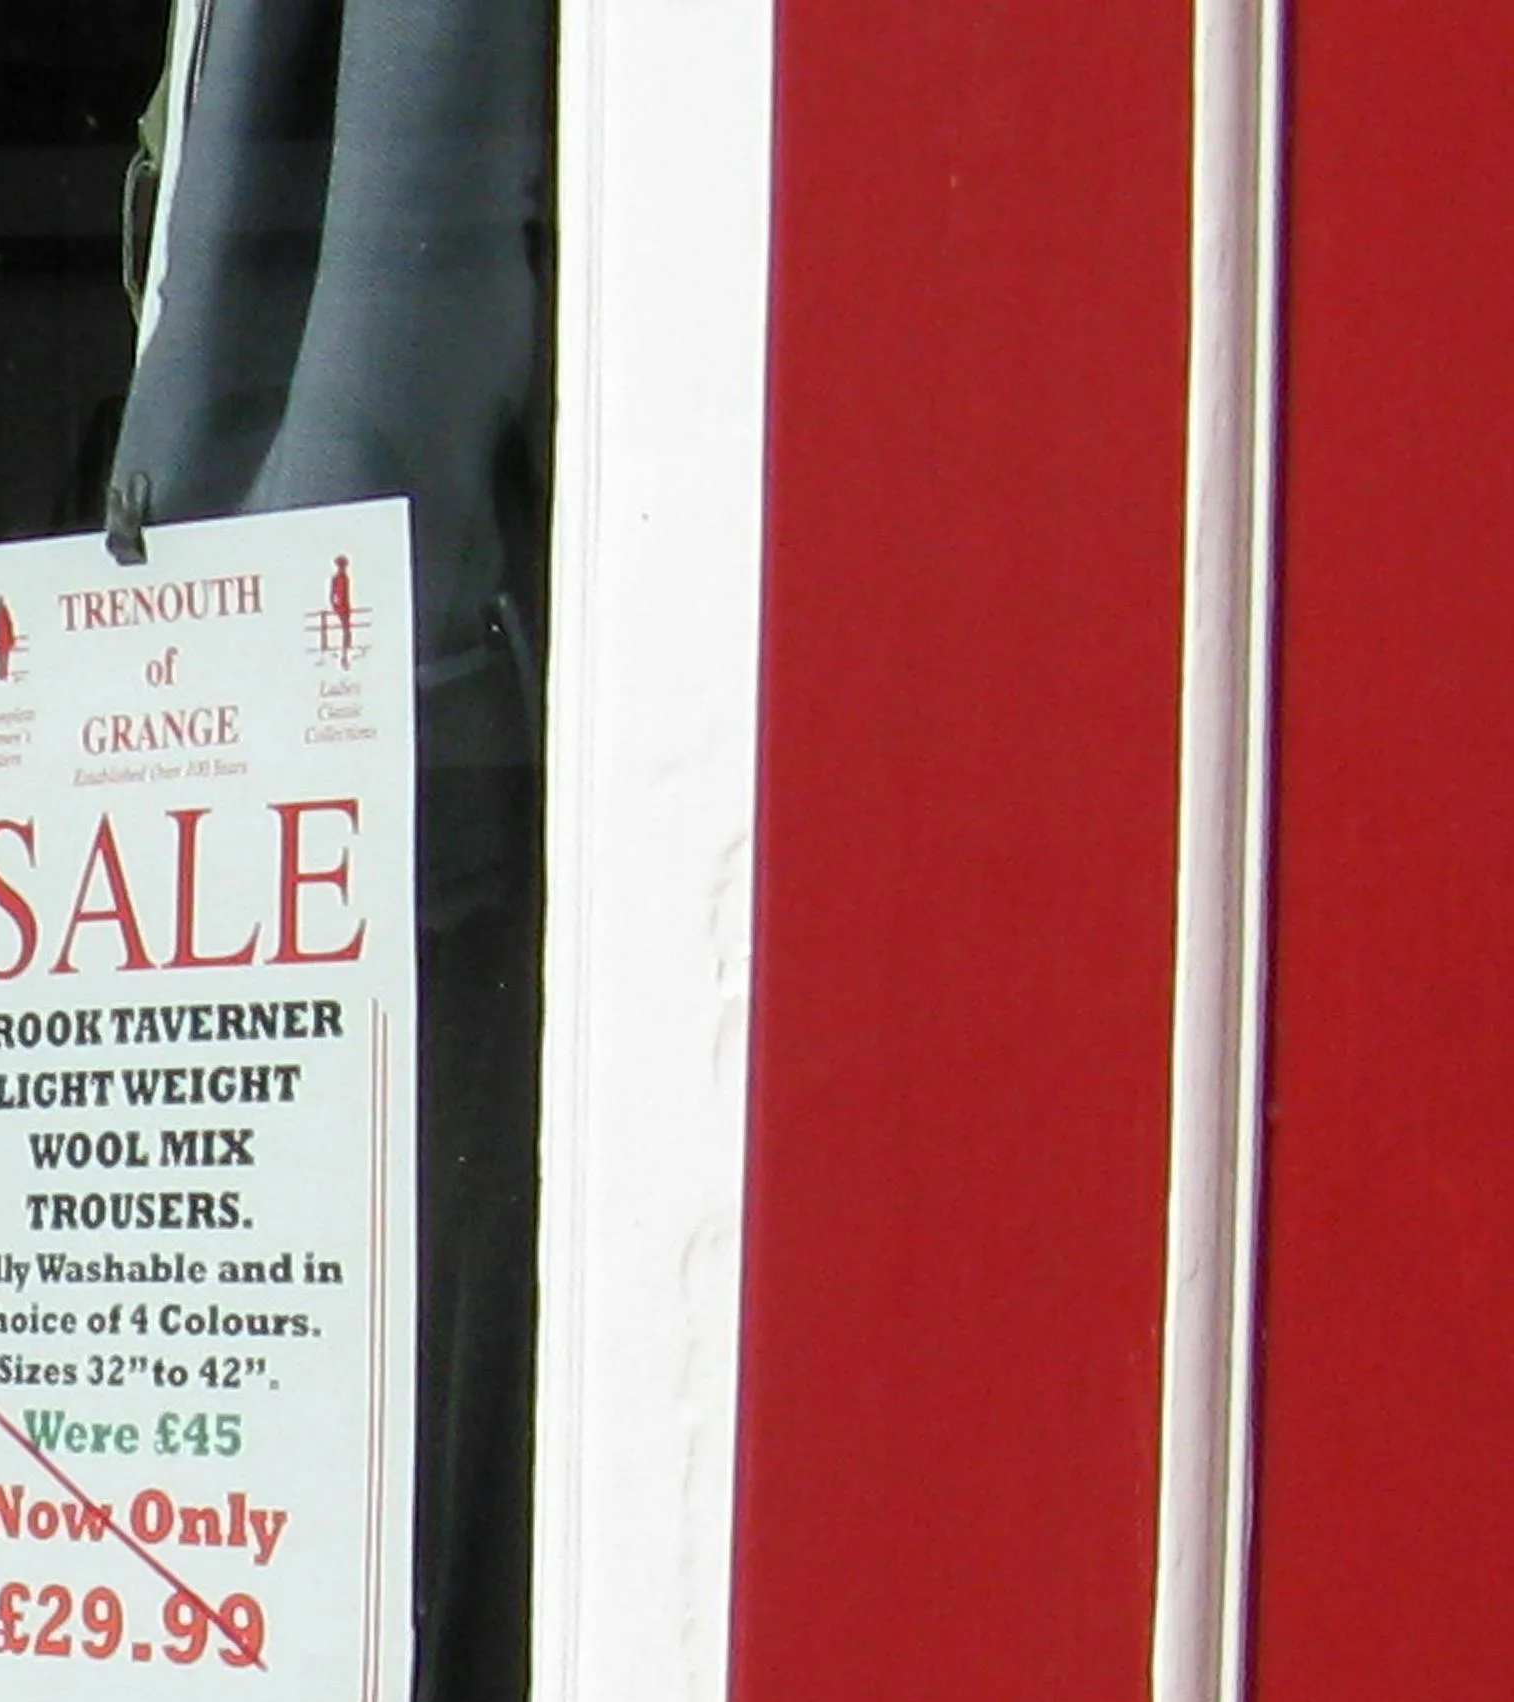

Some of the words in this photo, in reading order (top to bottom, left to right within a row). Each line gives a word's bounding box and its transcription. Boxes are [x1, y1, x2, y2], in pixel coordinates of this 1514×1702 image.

[59, 574, 264, 632] TRENOUTH
[146, 647, 178, 688] of
[82, 705, 239, 756] GRANGE
[110, 999, 344, 1046] TAVERNER
[121, 1064, 302, 1106] WEIGHT
[28, 1131, 150, 1169] WOOL
[159, 1128, 255, 1168] MIX
[26, 1191, 254, 1231] TROUSERS.
[35, 1253, 208, 1285] Washable
[217, 1253, 293, 1286] and
[303, 1253, 344, 1285] in
[87, 1304, 124, 1336] of
[130, 1306, 149, 1336] 4
[159, 1304, 322, 1338] Colours.
[152, 1357, 189, 1387] to
[23, 1410, 140, 1456] Were
[153, 1412, 243, 1457] £45
[130, 1488, 288, 1566] Only
